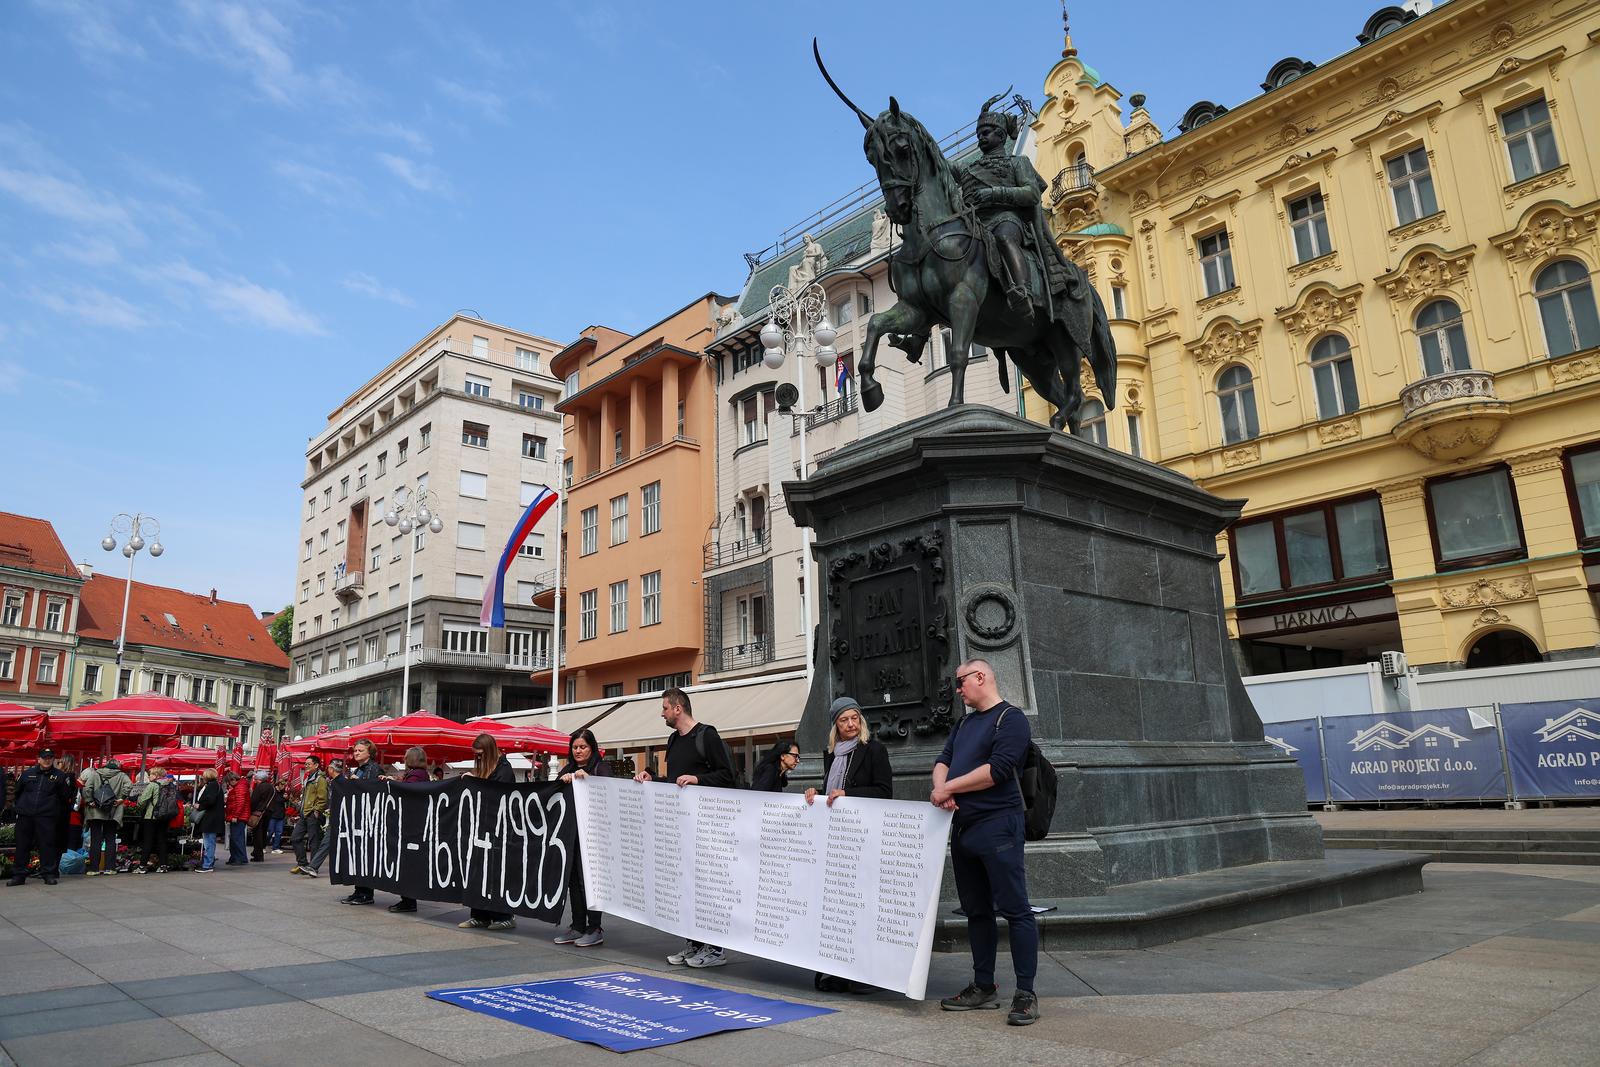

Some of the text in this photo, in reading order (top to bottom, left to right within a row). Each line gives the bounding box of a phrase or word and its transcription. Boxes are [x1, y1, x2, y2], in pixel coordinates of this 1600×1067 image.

[1273, 605, 1357, 631] HARMICA
[1350, 758, 1477, 775] AGRAD PROJEKT d.o.o.
[1537, 752, 1587, 768] AGRAD
[1378, 783, 1450, 792] info@agradprojekt.hr
[335, 781, 402, 882] AHMIĆI
